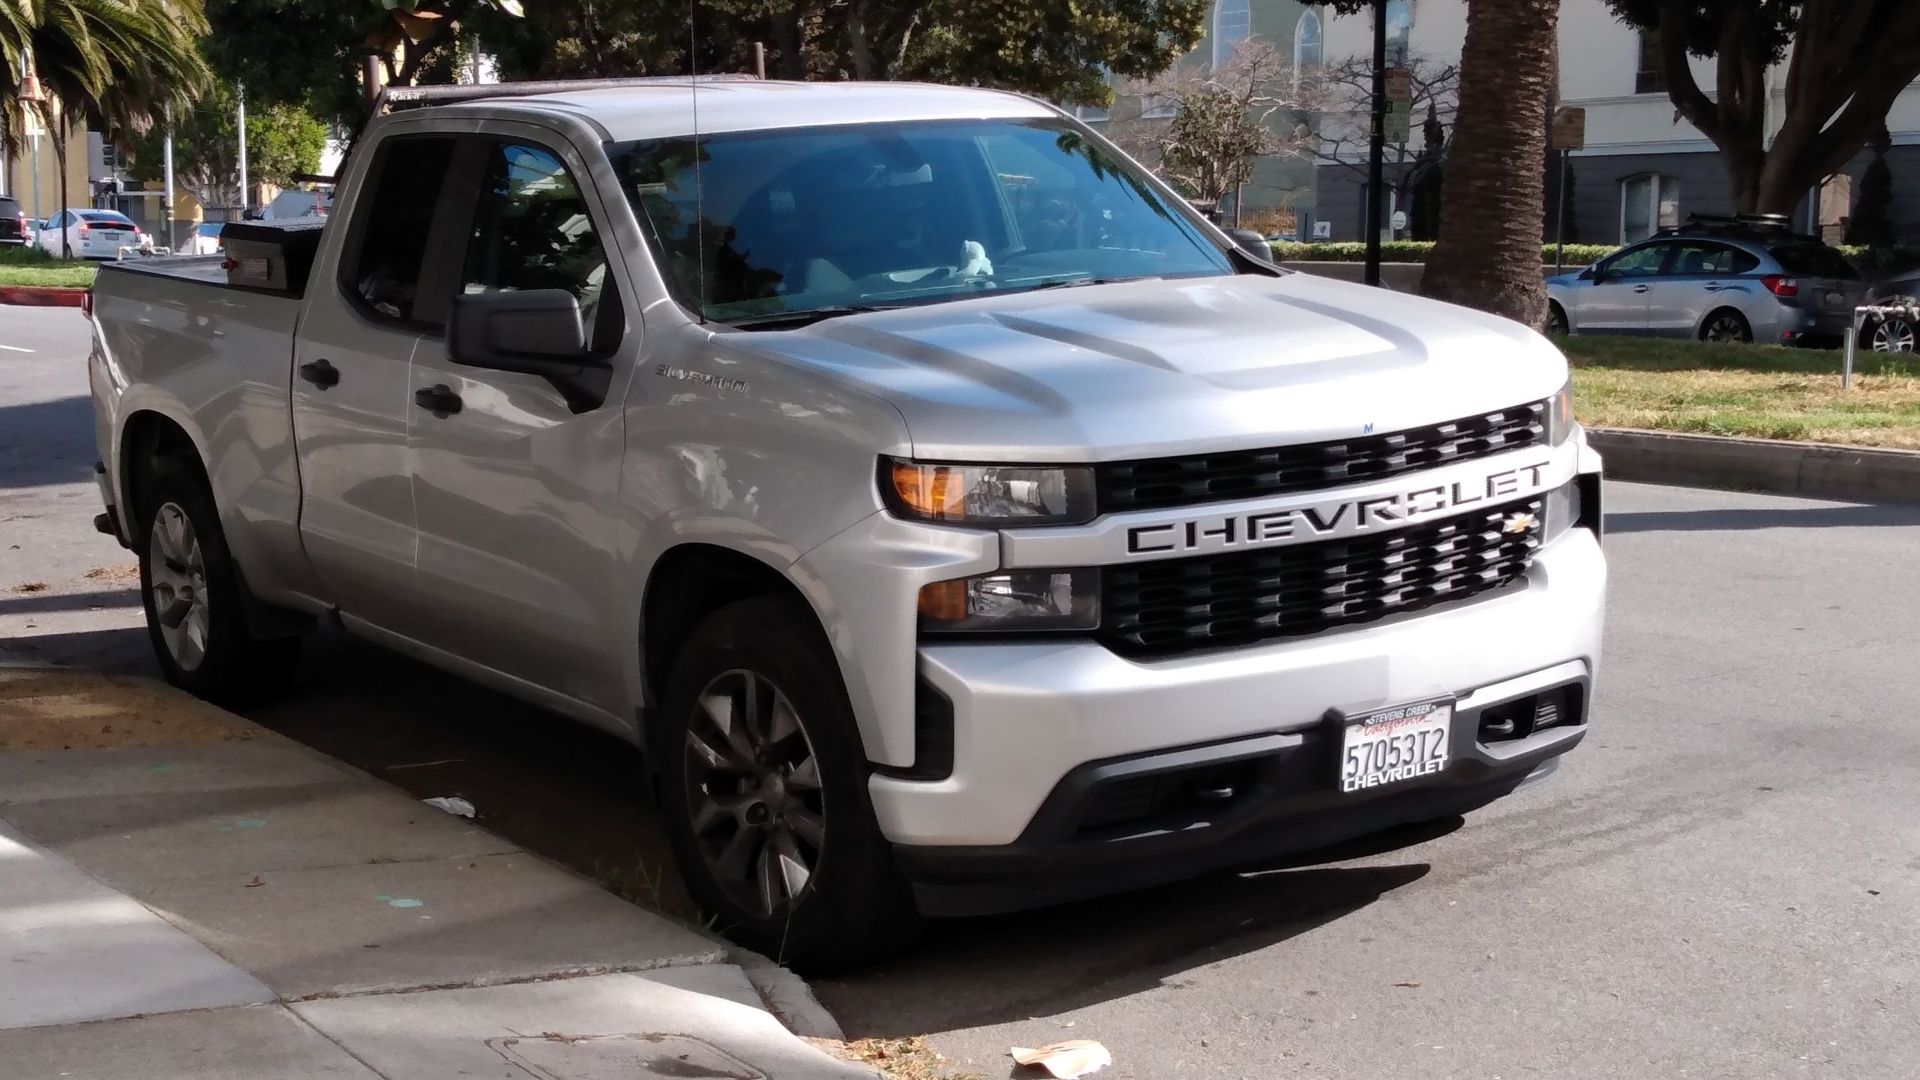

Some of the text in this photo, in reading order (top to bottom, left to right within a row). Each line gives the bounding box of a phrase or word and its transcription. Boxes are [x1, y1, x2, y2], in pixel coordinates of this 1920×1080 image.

[1363, 422, 1374, 434] M
[1126, 460, 1551, 555] CHEVROLET
[1369, 703, 1432, 725] STEVENS CREEK
[1346, 727, 1445, 778] 57053T2
[1343, 754, 1448, 793] CHEVROLET
